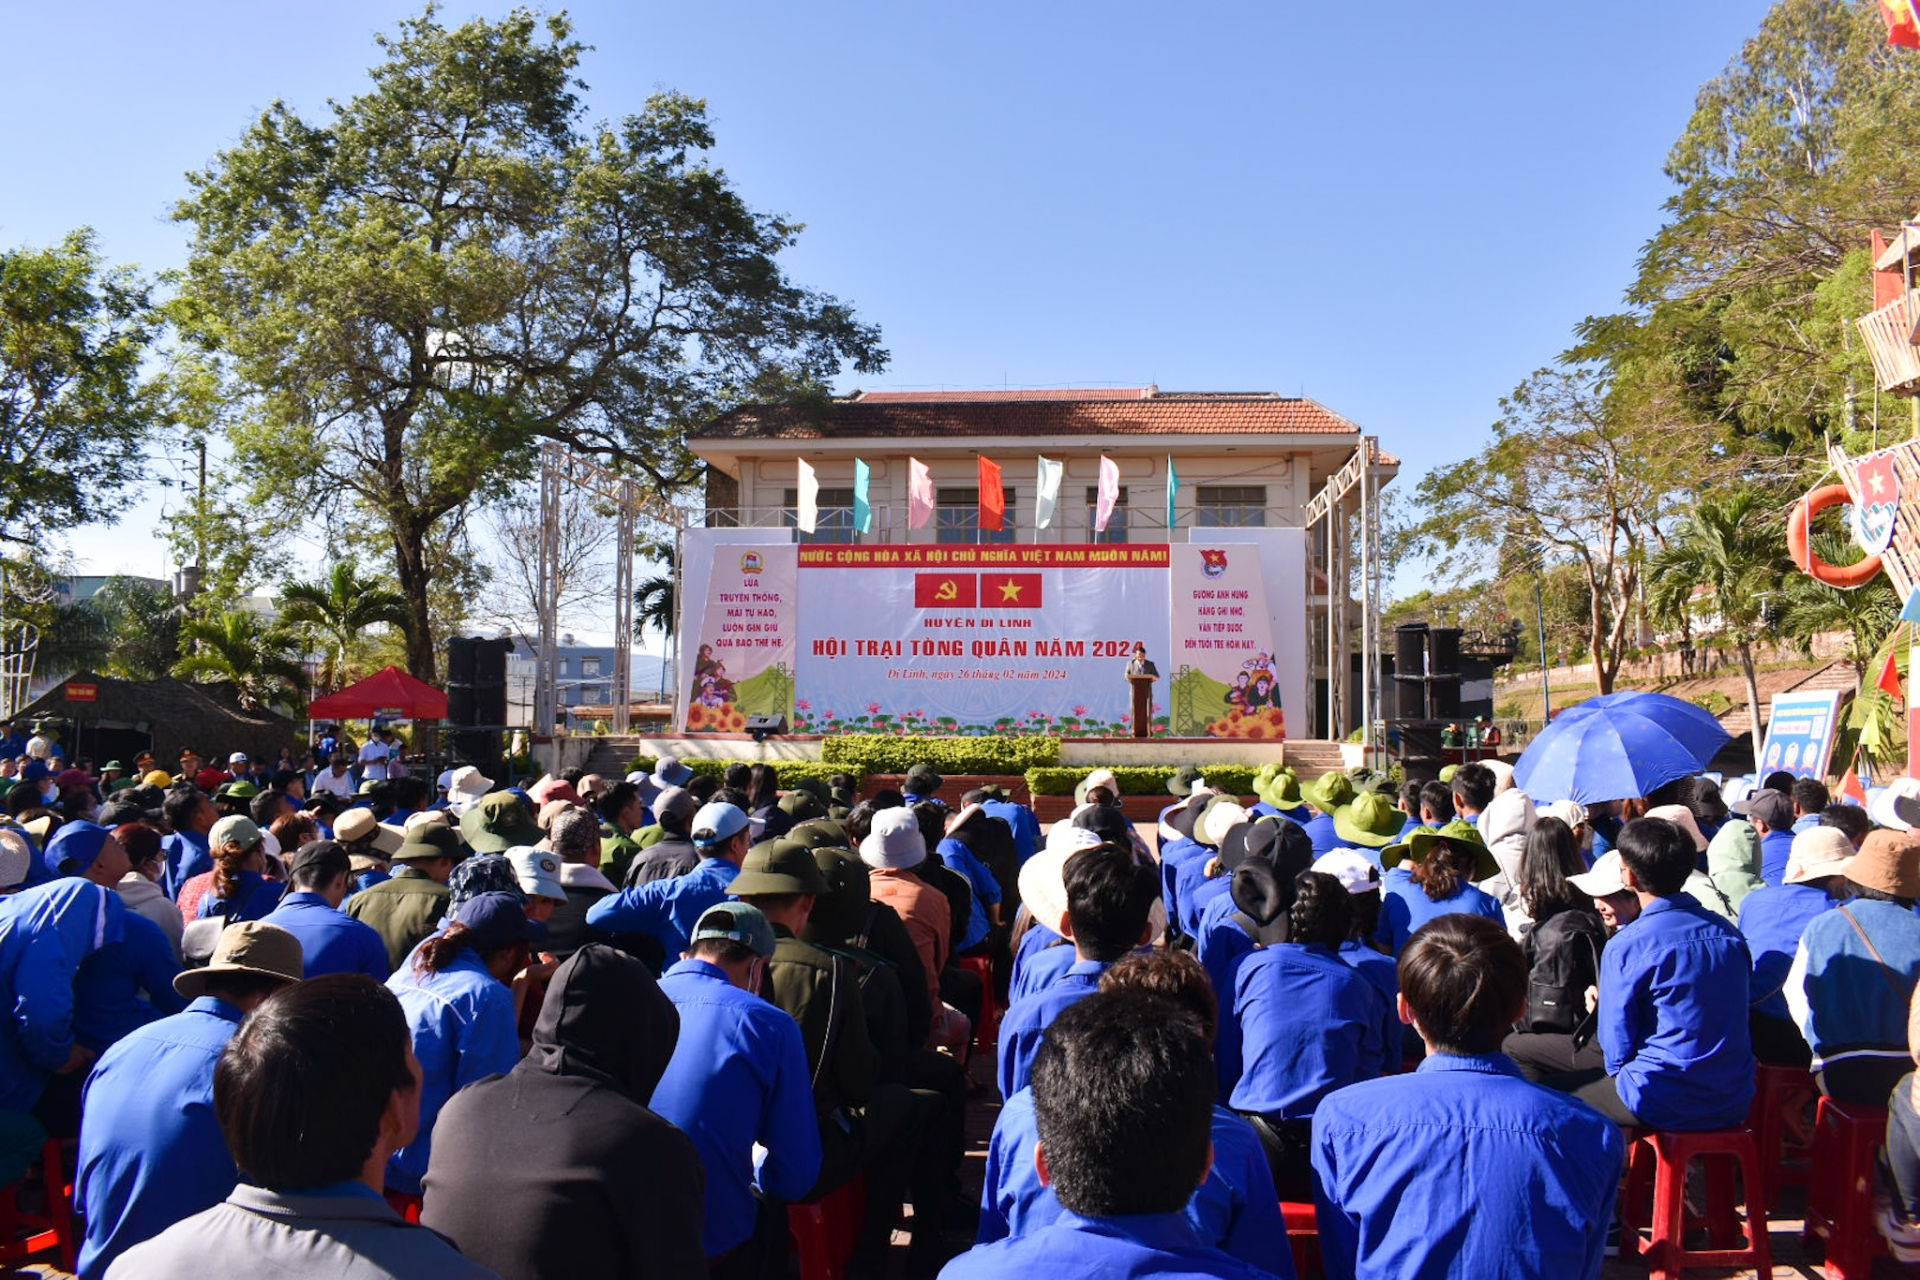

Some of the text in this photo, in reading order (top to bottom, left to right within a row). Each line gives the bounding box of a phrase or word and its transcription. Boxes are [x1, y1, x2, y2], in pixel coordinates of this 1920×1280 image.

[837, 548, 870, 564] CỘNG
[904, 549, 922, 562] XÃ
[926, 549, 948, 564] HỘI
[951, 548, 977, 562] CHỦ
[980, 549, 1018, 562] NGHĨA
[1022, 549, 1051, 564] VIỆT
[1055, 550, 1085, 562] NAM
[981, 618, 994, 628] DI
[999, 618, 1032, 628] LINH
[812, 636, 847, 660] HỘI
[855, 639, 902, 660] TRẠI
[910, 636, 964, 657] TÒNG
[971, 637, 1027, 659] QUÂN
[1035, 637, 1085, 657] NĂM
[902, 668, 928, 680] Linh,
[931, 670, 954, 681] ngày
[957, 669, 970, 679] 26
[972, 669, 1000, 680] tháng
[1003, 669, 1015, 679] 02
[1017, 670, 1040, 679] năm
[1042, 669, 1067, 679] 2024
